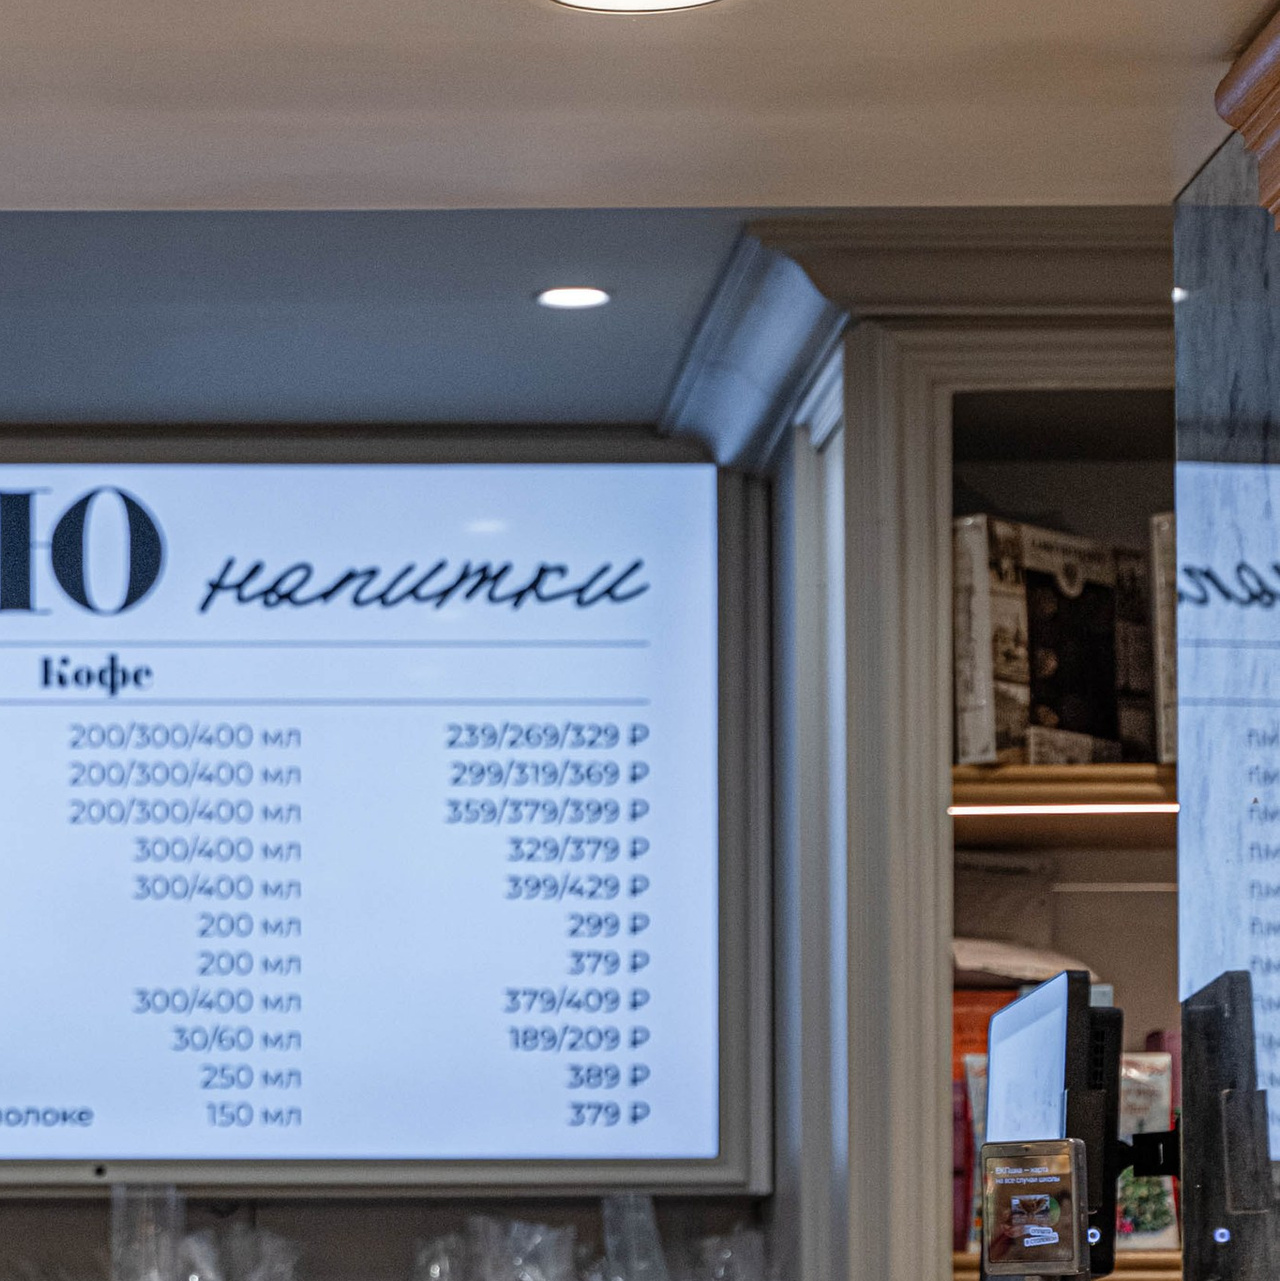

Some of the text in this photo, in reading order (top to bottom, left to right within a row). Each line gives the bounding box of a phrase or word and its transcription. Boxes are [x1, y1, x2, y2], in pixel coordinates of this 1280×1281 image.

[200, 554, 651, 616] напитки
[38, 654, 154, 697] Кофе
[70, 722, 253, 749] 200/300/400
[260, 728, 301, 747] мл
[446, 721, 620, 749] 239/269/329
[69, 759, 253, 787] 200/300/400
[261, 767, 301, 786] мл
[450, 759, 620, 787] 299/319/369
[69, 797, 253, 824] 200/300/400
[261, 804, 301, 823] мл
[445, 797, 620, 825] 359/379/399
[134, 836, 254, 862] 300/400
[261, 842, 301, 861] мл
[507, 835, 620, 862] 329/379
[134, 874, 254, 900] 300/400
[260, 880, 301, 899] мл
[505, 873, 620, 901] 399/429
[197, 912, 254, 938] 200
[260, 917, 301, 937] мл
[567, 912, 620, 938] 299
[198, 951, 254, 976] 200
[261, 955, 301, 975] мл
[567, 950, 621, 976] 379
[133, 987, 254, 1014] 300/400
[261, 994, 301, 1013] мл
[504, 986, 621, 1014] 379/409
[172, 1025, 254, 1051] 30/60
[261, 1031, 301, 1050] мл
[508, 1024, 621, 1052] 189/209
[201, 1063, 254, 1089] 250
[260, 1069, 302, 1088] мл
[566, 1063, 621, 1089] 389
[206, 1101, 254, 1127] 150
[261, 1107, 301, 1126] мл
[568, 1101, 621, 1127] 379
